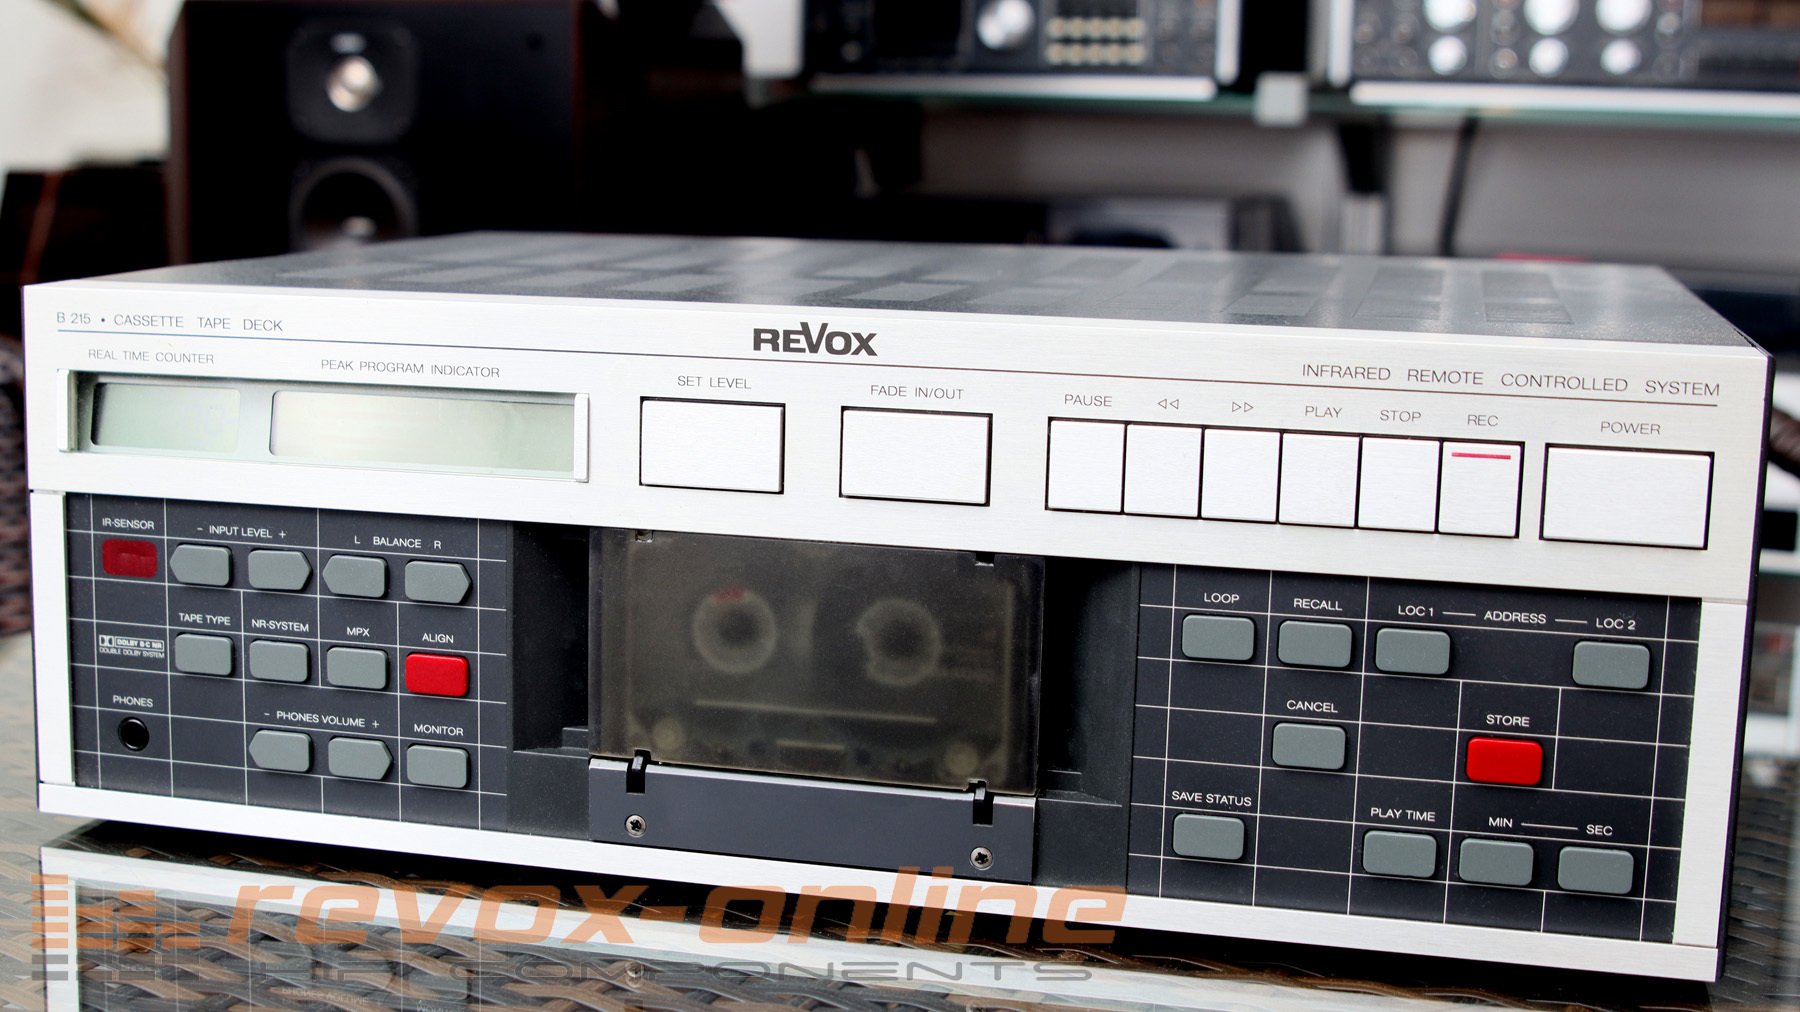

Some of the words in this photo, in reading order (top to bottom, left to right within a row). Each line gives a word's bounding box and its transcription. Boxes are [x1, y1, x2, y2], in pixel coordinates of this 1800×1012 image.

[56, 311, 66, 324] B
[70, 312, 92, 325] 215
[113, 314, 184, 328] CASSETTE
[197, 316, 231, 330] TAPE
[243, 318, 283, 332] DECK
[752, 321, 878, 357] REVOX
[88, 348, 117, 361] REAL
[122, 350, 150, 362] TIME
[155, 351, 215, 365] COUNTER
[321, 359, 354, 372] PEAK
[359, 361, 424, 374] PROGRAM
[430, 364, 500, 379] INDICATOR
[677, 375, 703, 387] SET
[709, 376, 752, 390] LEVEL
[1302, 363, 1391, 381] INFRARED
[1407, 368, 1484, 385] REMOTE
[1501, 374, 1628, 392] CONTROLLED
[1644, 379, 1720, 397] SYSTEM
[870, 384, 907, 398] FADE
[914, 386, 963, 400] IN/OUT
[1064, 393, 1113, 408] PAUSE
[1304, 405, 1343, 418] PLAY
[1379, 409, 1422, 423] STOP
[1467, 414, 1499, 427] REC
[1600, 421, 1661, 435] POWER
[102, 517, 155, 530] IR-SENSOR
[209, 523, 239, 536] INPUT
[241, 527, 273, 539] LEVEL
[354, 535, 361, 545] L
[372, 535, 422, 549] BALANCE
[433, 540, 442, 550] R
[1203, 592, 1240, 604] LOOP
[1293, 597, 1343, 611] RECALL
[1397, 604, 1426, 617] LOC
[1428, 607, 1434, 617] 1
[1483, 610, 1547, 625] ADDRESS
[178, 612, 204, 624] TAPE
[205, 614, 231, 626] TYPE
[251, 619, 309, 632] NR-SYSTEM
[1595, 617, 1625, 630] LOC
[1627, 619, 1636, 631] 2
[346, 626, 370, 637] MPX
[421, 632, 454, 644] ALIGN
[112, 694, 154, 708] PHONES
[1286, 699, 1339, 714] CANCEL
[276, 710, 320, 724] PHONES
[321, 714, 366, 728] VOLUME
[1485, 713, 1530, 728] STORE
[413, 723, 464, 737] MONITOR
[1171, 790, 1203, 803] SAVE
[1205, 793, 1252, 808] STATUS
[1370, 807, 1403, 819] PLAY
[1405, 809, 1436, 822] TIME
[1488, 816, 1513, 828] MIN
[1585, 824, 1613, 837] SEC
